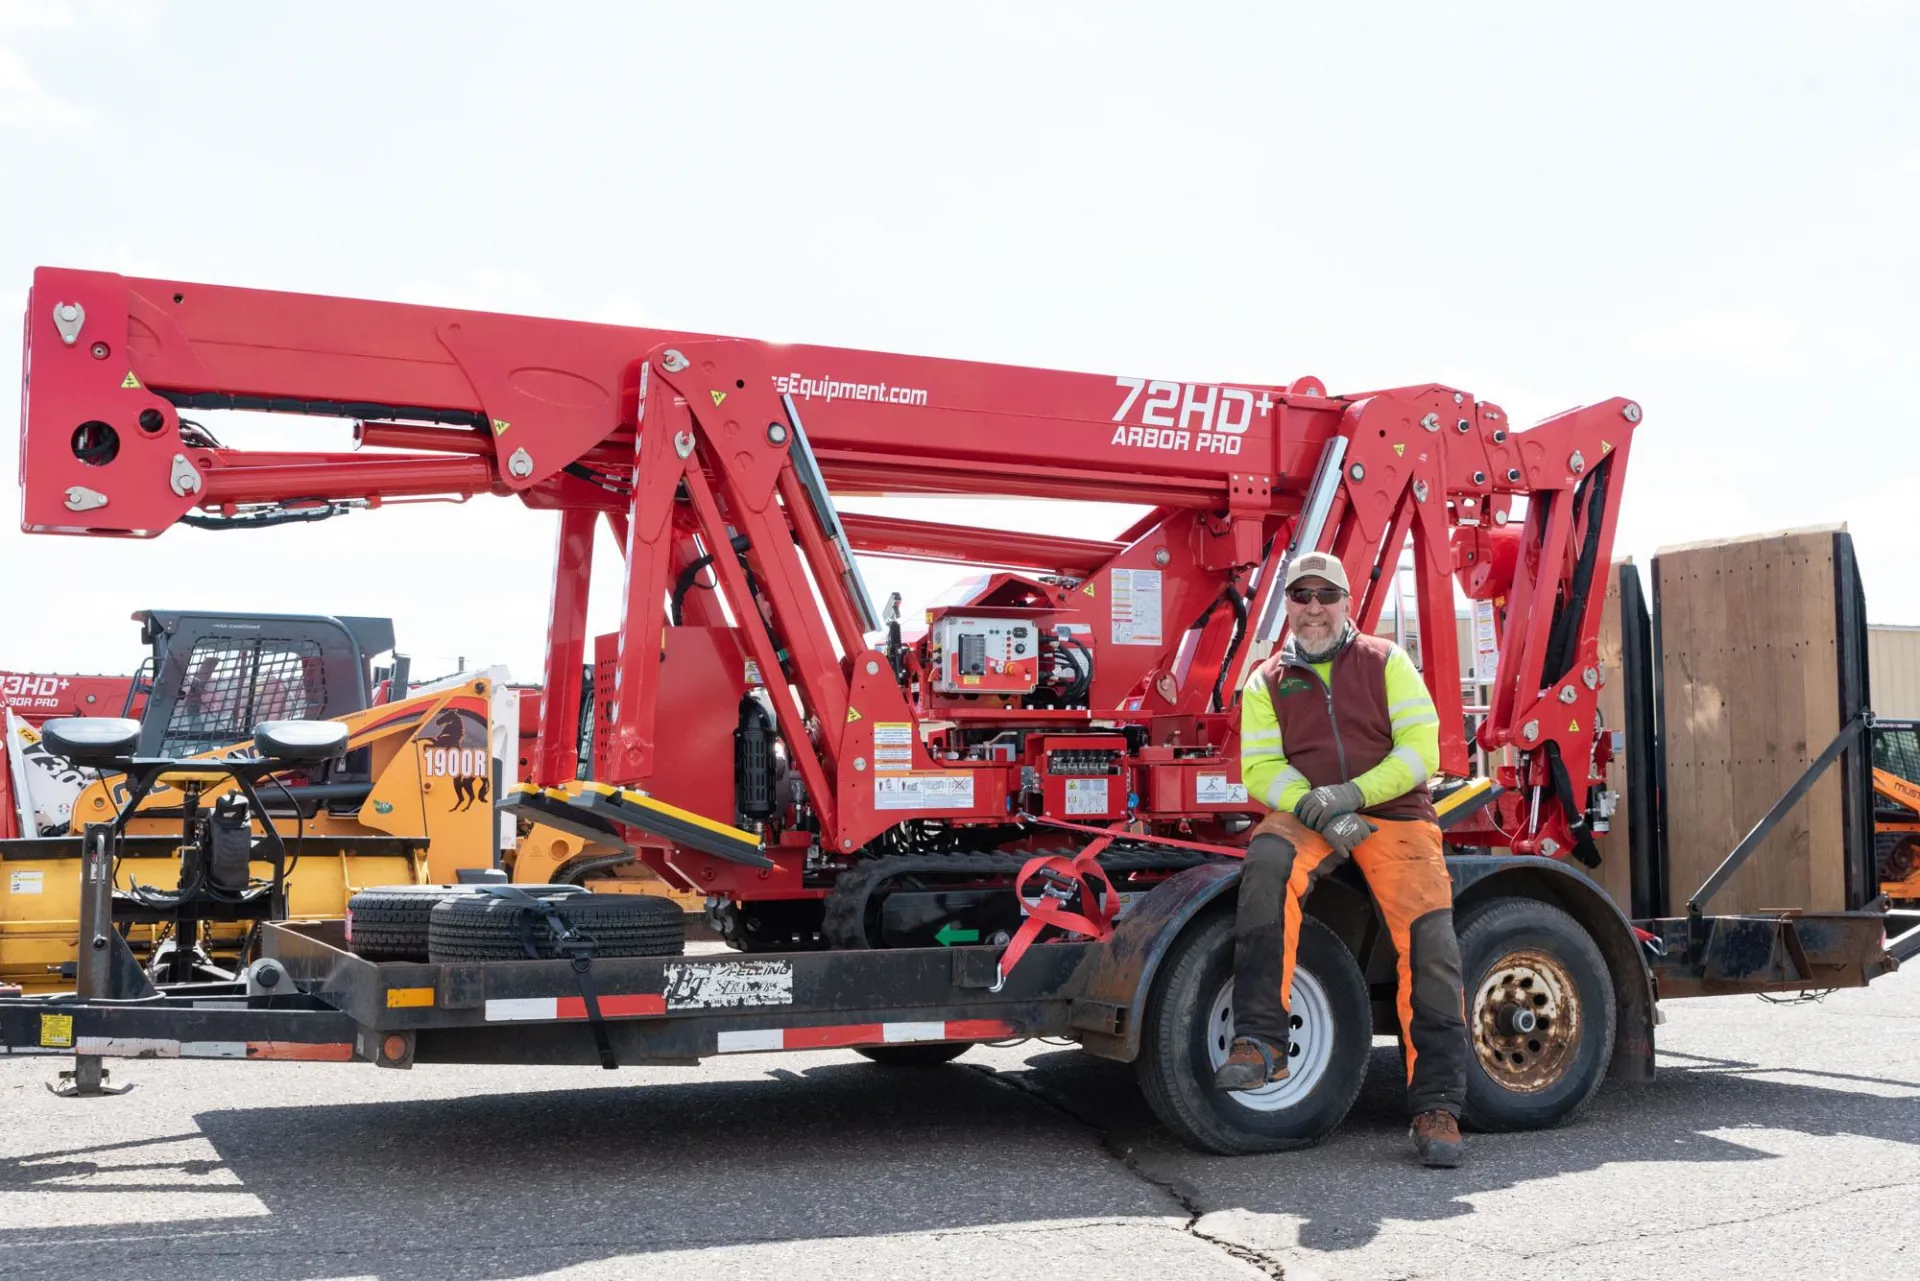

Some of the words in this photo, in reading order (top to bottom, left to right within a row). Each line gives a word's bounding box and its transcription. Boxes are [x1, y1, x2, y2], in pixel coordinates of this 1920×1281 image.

[772, 373, 928, 406] sEquipment.com
[1112, 376, 1274, 434] 72HD+
[1111, 425, 1191, 451] ARBOR
[1195, 432, 1242, 456] PRO
[34, 697, 59, 707] PRO
[424, 748, 486, 777] 1900R
